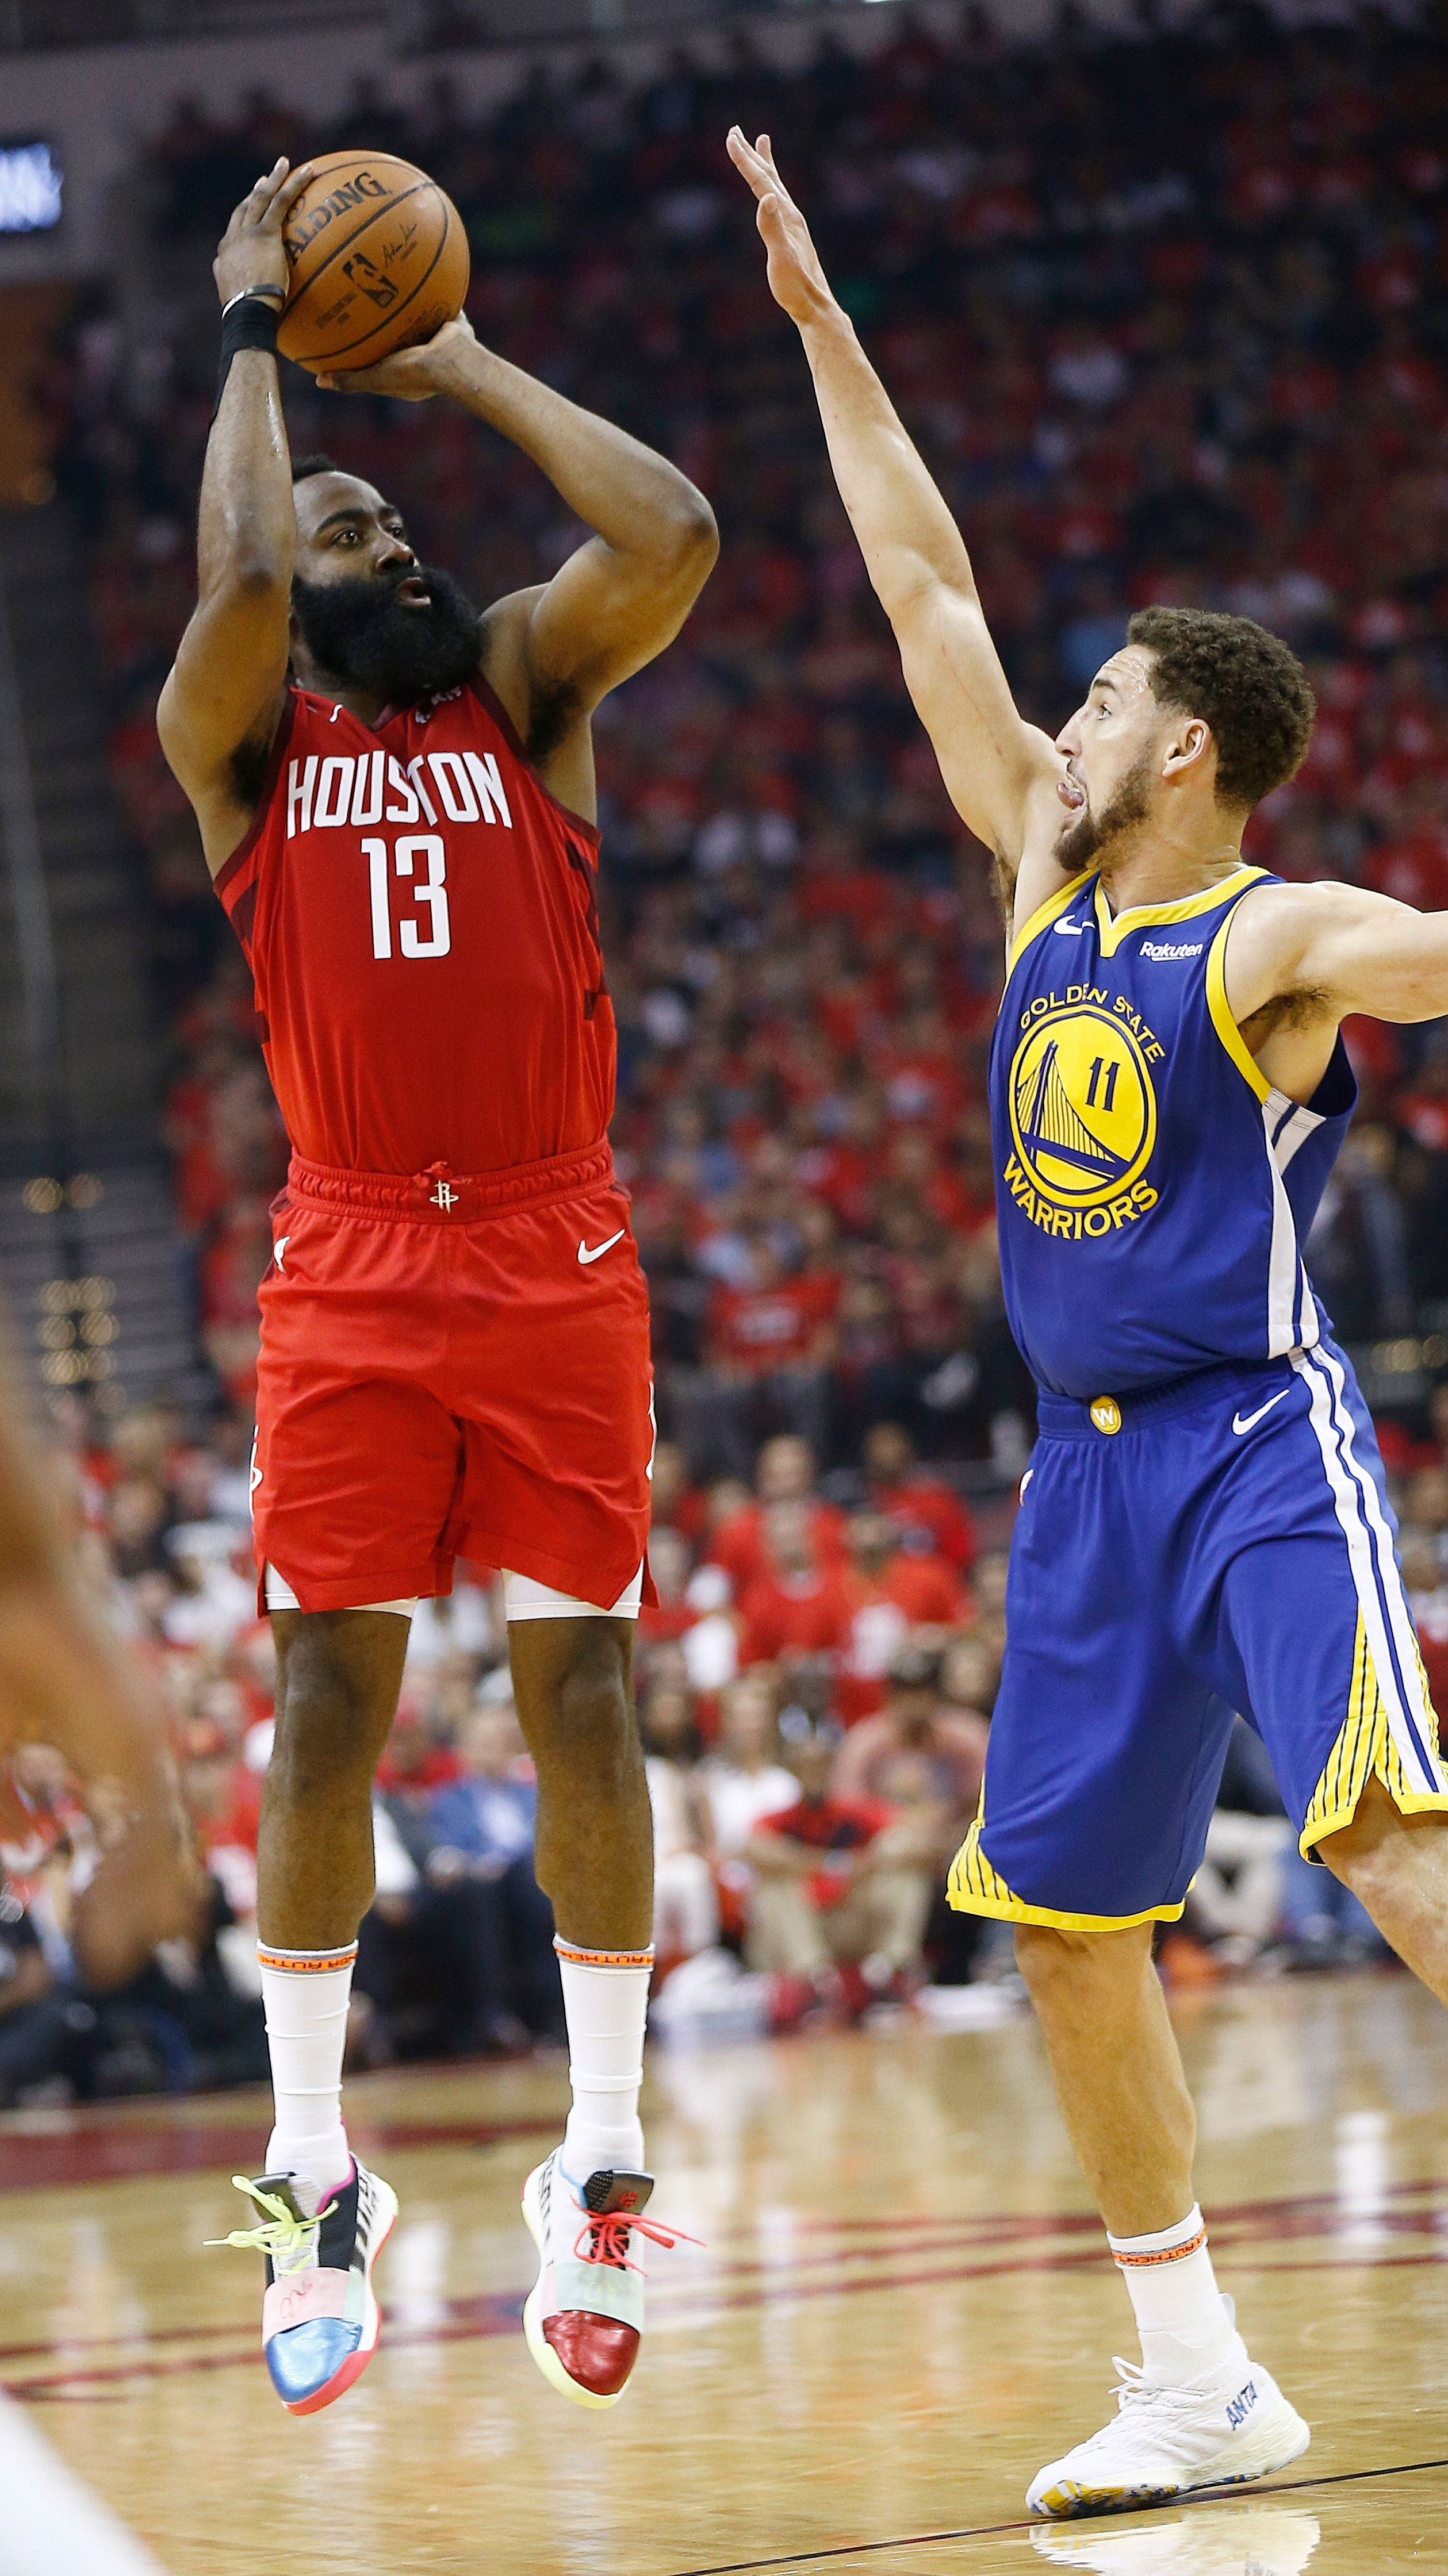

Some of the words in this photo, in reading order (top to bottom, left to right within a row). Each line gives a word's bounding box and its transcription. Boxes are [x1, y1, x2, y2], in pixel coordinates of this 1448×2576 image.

[284, 172, 386, 266] ALDING
[287, 750, 513, 840] HOUSTON
[361, 834, 451, 959] 13
[1139, 941, 1203, 958] Rakuten
[1021, 982, 1109, 1030] GOLDEN
[1113, 995, 1166, 1064] STATE
[1085, 1057, 1120, 1112] 11
[1002, 1152, 1159, 1241] WARRIORS
[1225, 2380, 1257, 2432] ANTA
